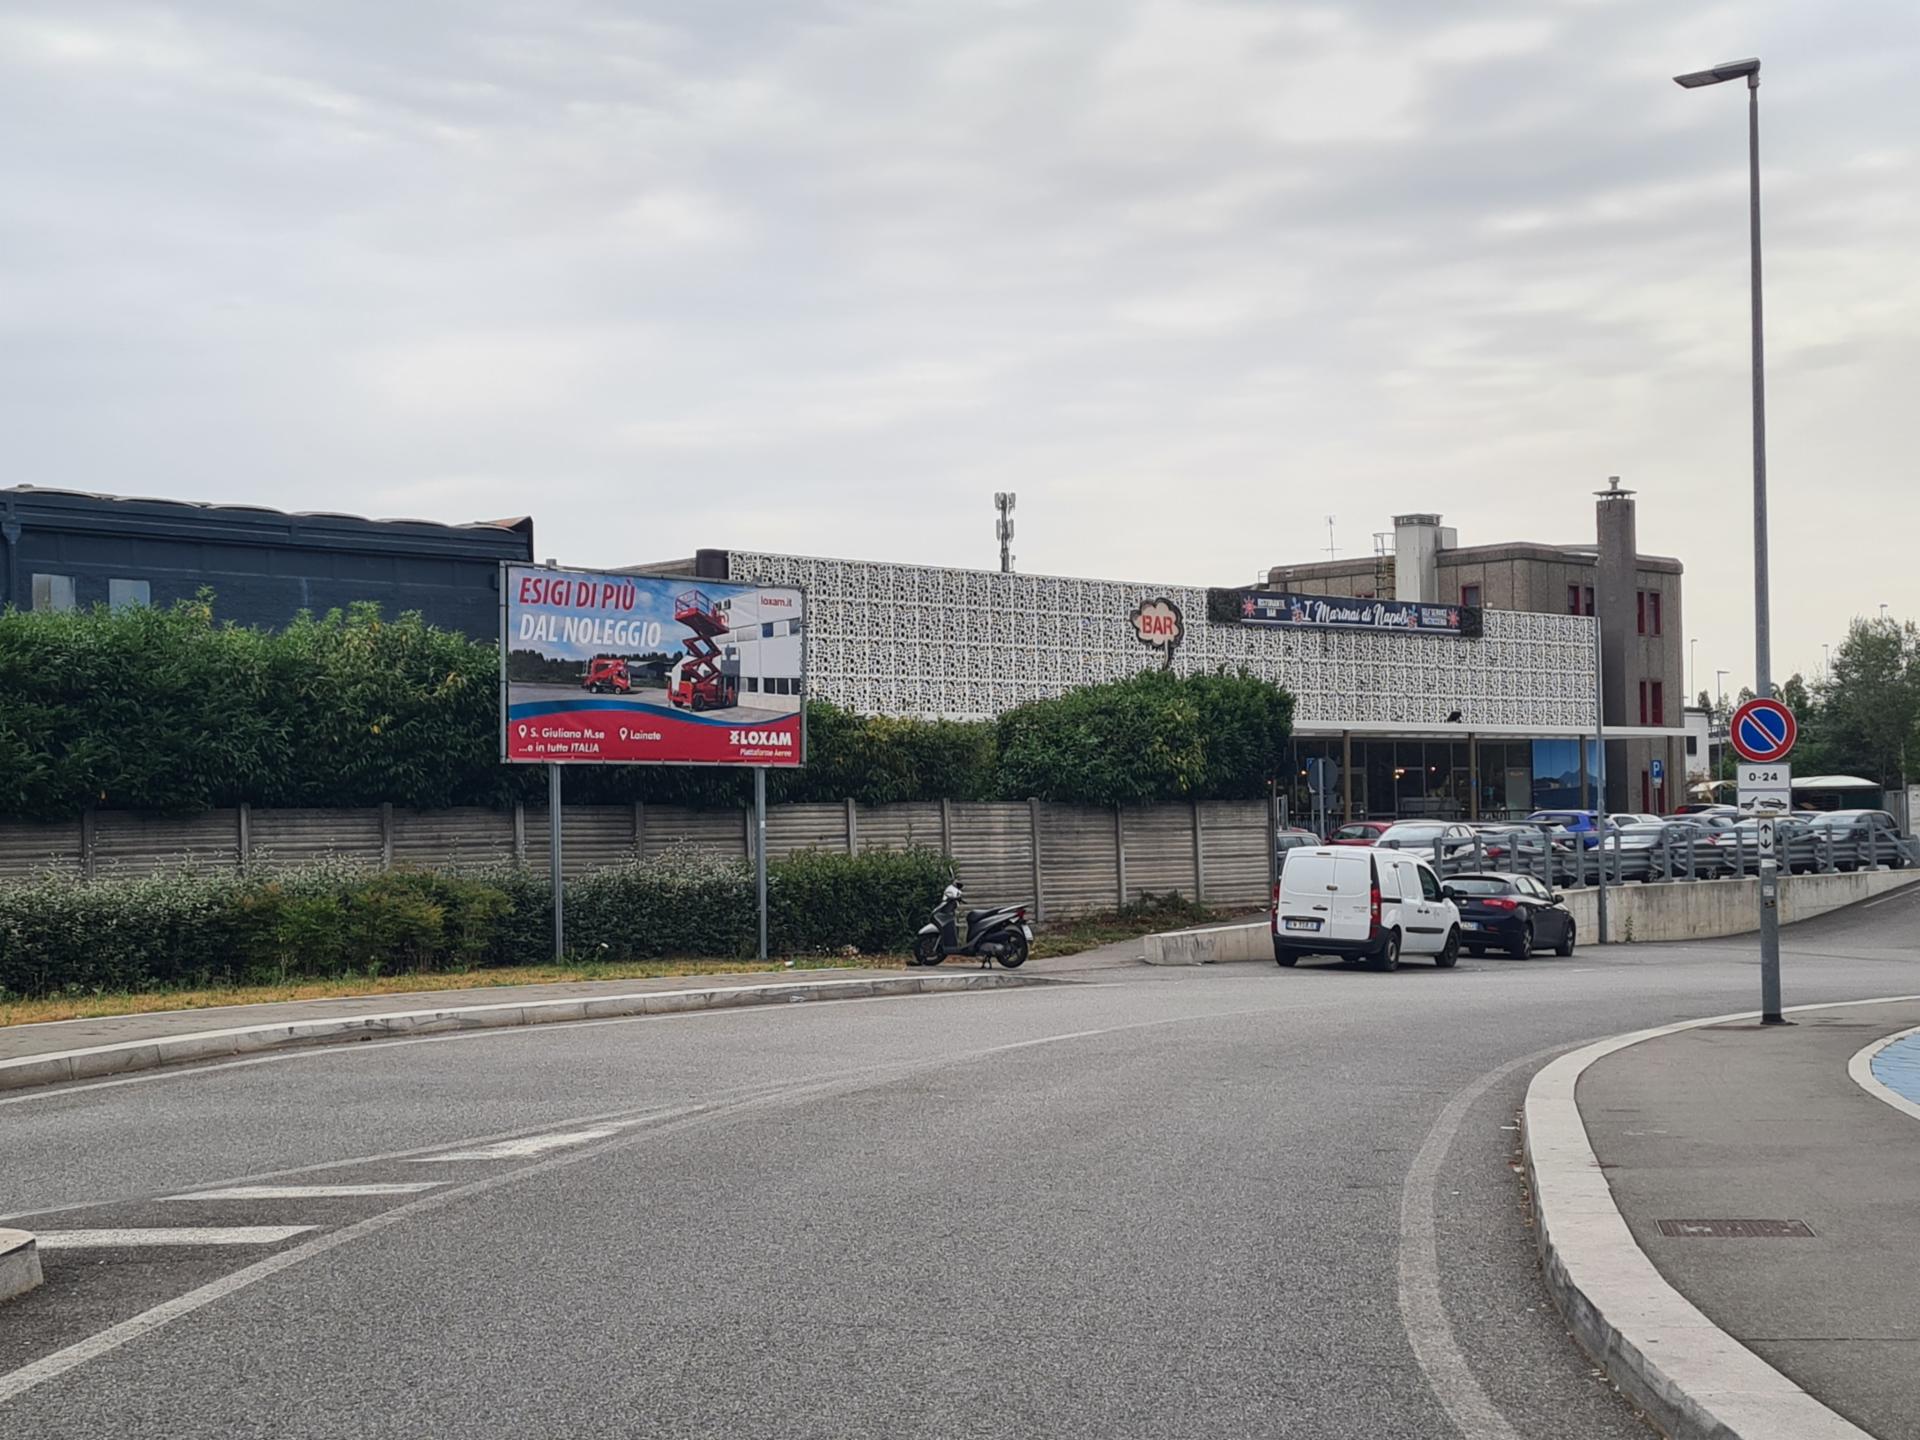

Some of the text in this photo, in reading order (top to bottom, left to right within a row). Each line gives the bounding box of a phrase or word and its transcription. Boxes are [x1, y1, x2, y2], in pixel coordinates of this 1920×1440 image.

[519, 577, 637, 610] ESIGI DI PIÙ
[760, 595, 792, 608] loxam.it
[1303, 600, 1313, 621] I
[1314, 601, 1360, 624] Marinai
[1361, 606, 1372, 622] di
[1373, 603, 1408, 630] Napoli
[519, 614, 662, 648] DAL NOLEGGIO
[1141, 614, 1174, 636] BAR
[530, 727, 605, 739] S. Giuliano M.se
[630, 730, 662, 741] Lainate
[740, 731, 792, 746] LOXAM
[536, 742, 545, 752] in
[547, 743, 568, 753] tutta
[571, 743, 600, 753] ITALIA
[1653, 761, 1660, 777] P
[1748, 772, 1778, 781] 0-24
